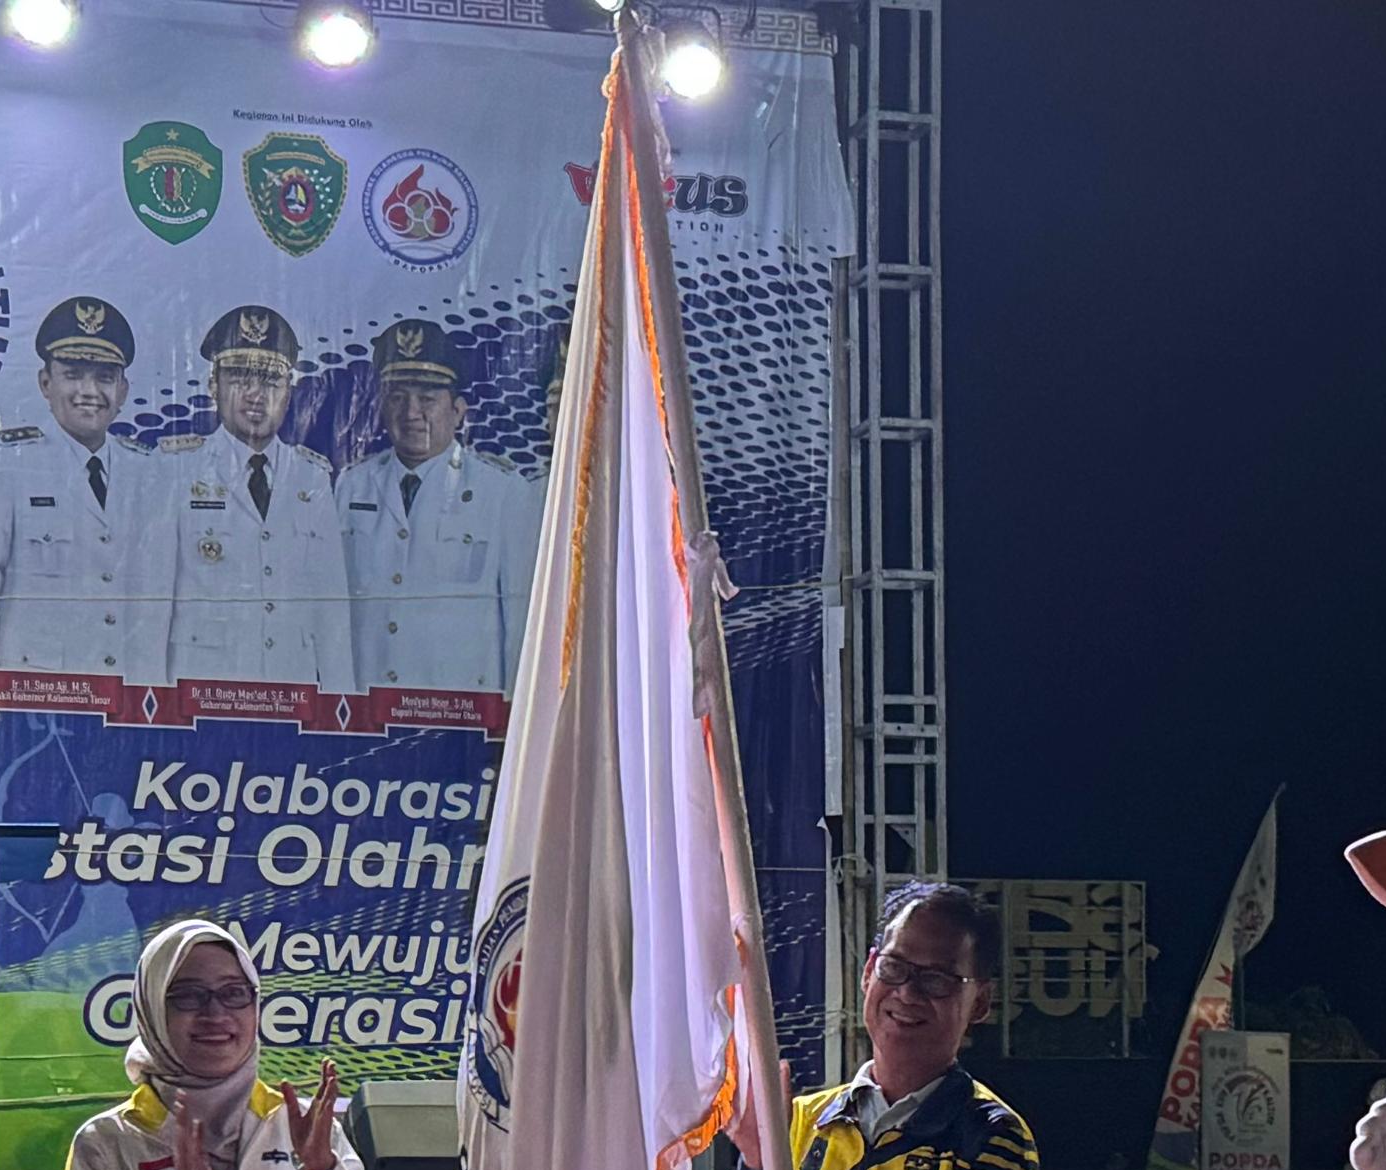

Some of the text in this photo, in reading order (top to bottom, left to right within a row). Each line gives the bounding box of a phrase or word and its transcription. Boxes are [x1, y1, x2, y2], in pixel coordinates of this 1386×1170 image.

[297, 113, 346, 128] Didukung
[132, 760, 497, 822] Kolaborasi
[257, 822, 486, 890] Olahr
[88, 978, 468, 1044] Gerasi
[1209, 1152, 1282, 1169] POPDA
